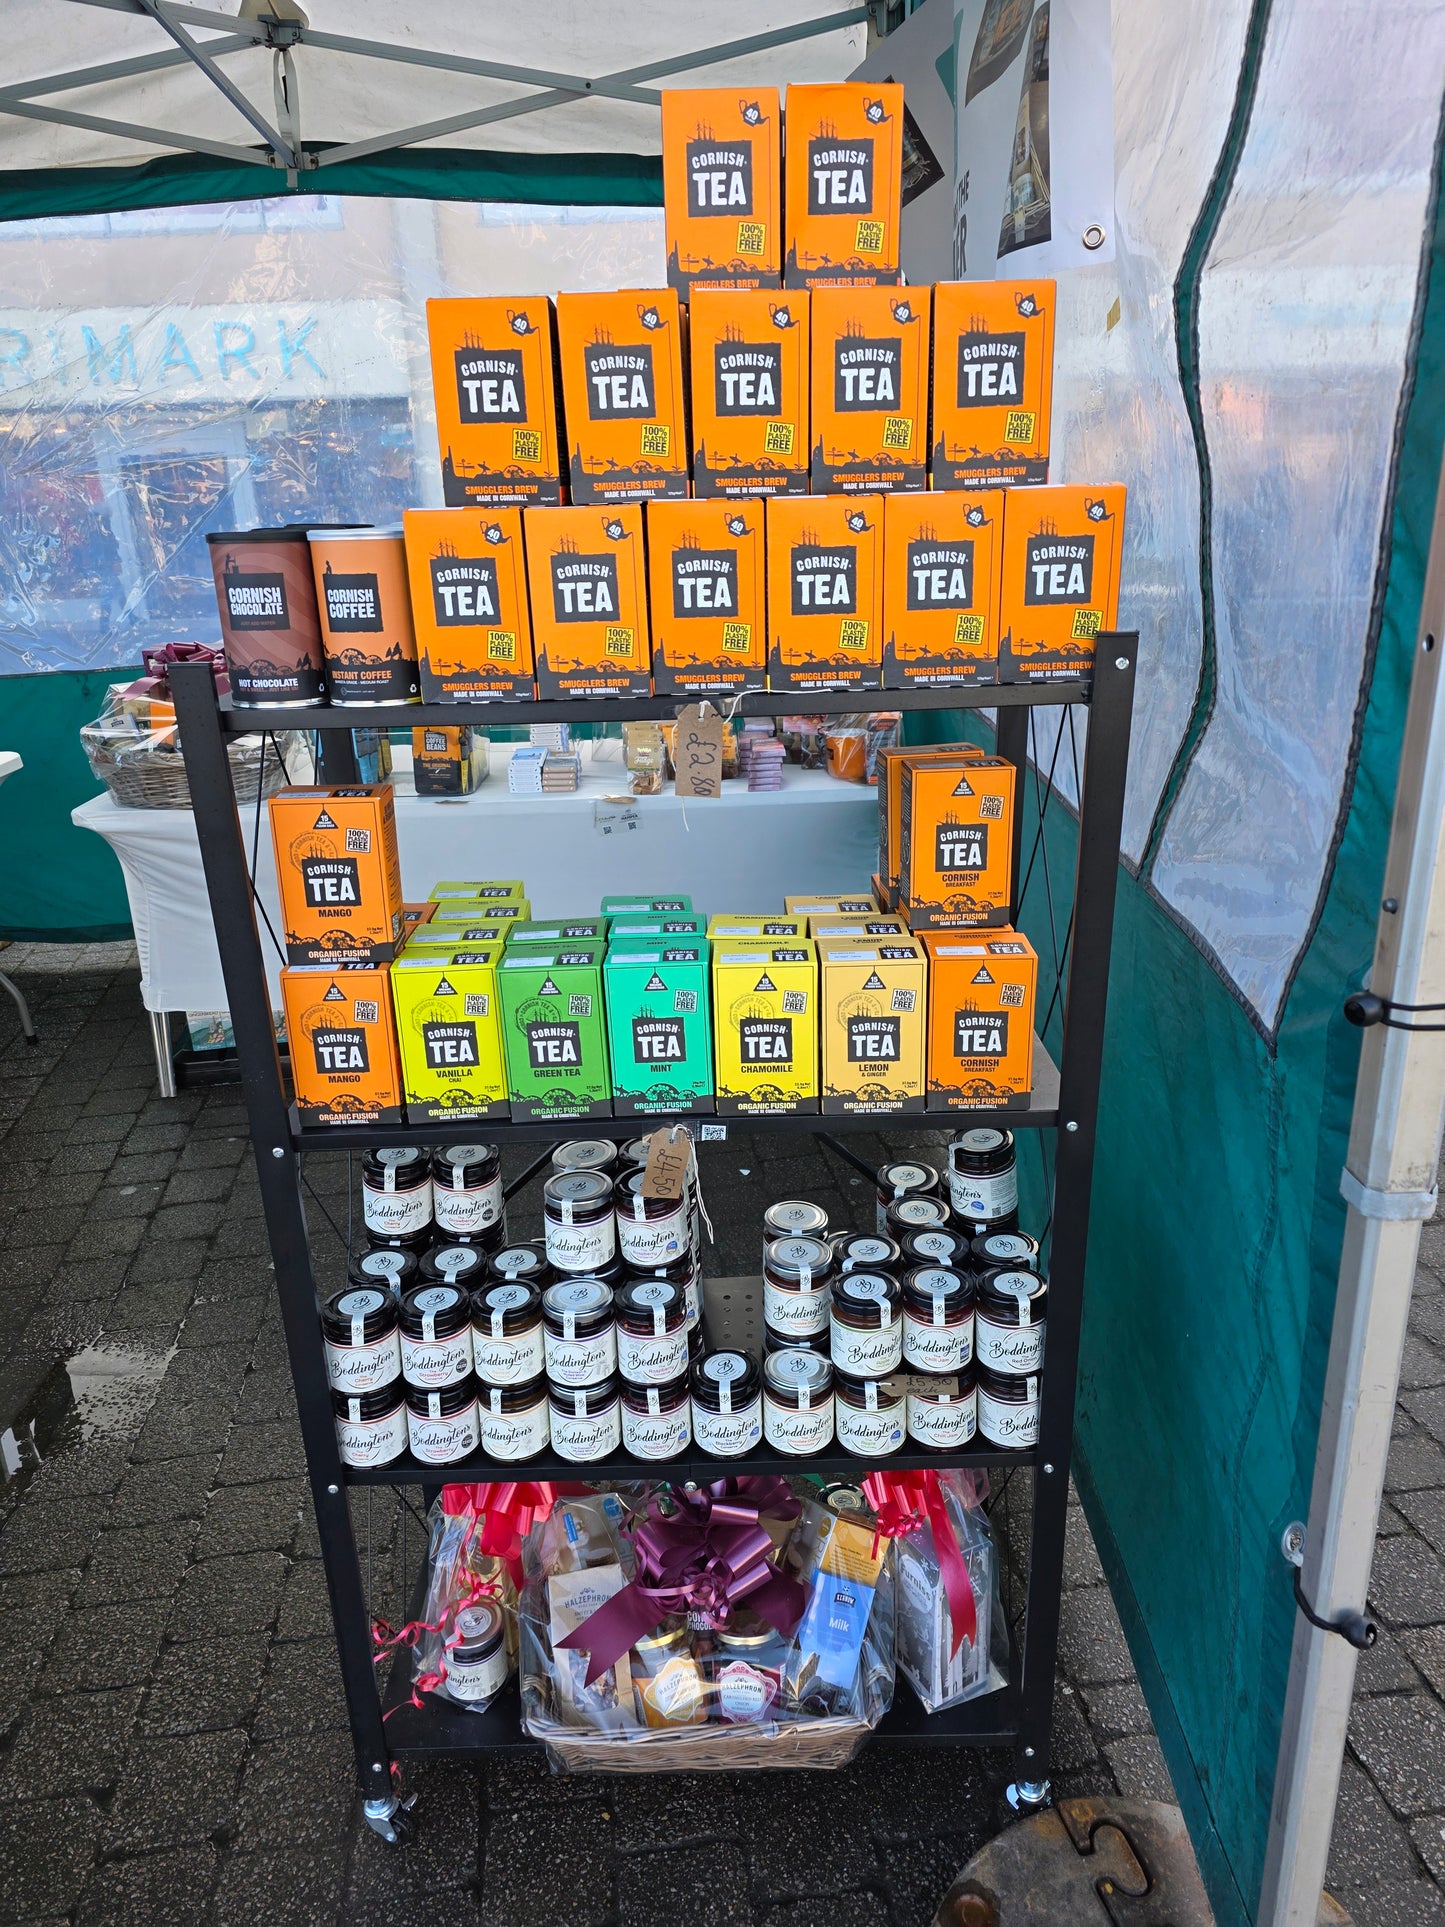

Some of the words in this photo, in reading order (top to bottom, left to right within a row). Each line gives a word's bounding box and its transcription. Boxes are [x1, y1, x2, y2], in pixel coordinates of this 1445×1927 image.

[692, 151, 744, 169] CORNISH
[813, 149, 866, 167] CORNISH
[693, 171, 747, 206] TEA
[814, 169, 866, 204] TEA
[688, 280, 735, 289] SMUGGLERS
[737, 279, 760, 288] BREW
[805, 278, 852, 287] SMUGGLERS
[853, 277, 877, 286] BREW
[840, 348, 894, 365] CORNISH
[964, 343, 1018, 361] CORNISH
[591, 355, 645, 373] CORNISH
[720, 353, 774, 370] CORNISH
[461, 360, 515, 376] CORNISH
[841, 367, 894, 401] TEA
[964, 362, 1017, 397] TEA
[592, 374, 649, 409] TEA
[721, 372, 775, 406] TEA
[463, 379, 520, 413] TEA
[768, 424, 792, 434] 100%
[515, 431, 539, 442] 100%
[767, 439, 791, 450] FREE
[515, 446, 539, 457] FREE
[832, 473, 880, 483] SMUGGLERS
[881, 472, 905, 481] BREW
[954, 468, 1002, 479] SMUGGLERS
[1003, 466, 1027, 476] BREW
[593, 481, 641, 491] SMUGGLERS
[642, 480, 666, 489] BREW
[715, 478, 763, 487] SMUGGLERS
[764, 477, 788, 486] BREW
[465, 485, 513, 495] SMUGGLERS
[515, 485, 538, 494] BREW
[488, 529, 500, 540] 40
[913, 550, 966, 567] CORNISH
[1032, 545, 1086, 561] CORNISH
[677, 559, 730, 575] CORNISH
[796, 555, 849, 571] CORNISH
[436, 567, 489, 583] CORNISH
[557, 563, 609, 579] CORNISH
[913, 568, 966, 600] TEA
[1032, 563, 1085, 595] TEA
[228, 587, 282, 603] CORNISH
[327, 588, 374, 602] CORNISH
[678, 577, 732, 608] TEA
[797, 573, 850, 605] TEA
[438, 585, 495, 616] TEA
[558, 581, 613, 613] TEA
[230, 603, 284, 616] CHOCOLATE
[329, 603, 376, 618] COFFEE
[958, 616, 983, 626] 100%
[956, 630, 981, 640] FREE
[904, 667, 951, 676] SMUGGLERS
[953, 666, 976, 674] BREW
[1019, 662, 1067, 671] SMUGGLERS
[1068, 661, 1093, 670] BREW
[331, 670, 358, 680] INSTANT
[360, 670, 392, 679] COFFEE
[674, 674, 721, 683] SMUGGLERS
[722, 674, 745, 682] BREW
[790, 672, 837, 681] SMUGGLERS
[838, 671, 862, 679] BREW
[238, 679, 251, 688] HOT
[252, 678, 299, 688] CHOCOLATE
[442, 682, 489, 691] SMUGGLERS
[490, 682, 513, 690] BREW
[558, 679, 605, 688] SMUGGLERS
[607, 678, 630, 687] BREW
[940, 830, 982, 842] CORNISH
[940, 843, 982, 866] TEA
[307, 864, 351, 876] CORNISH
[942, 873, 980, 882] CORNISH
[308, 877, 356, 901] TEA
[318, 909, 352, 918] MANGO
[930, 913, 961, 922] ORGANIC
[308, 950, 342, 959] ORGANIC
[342, 949, 371, 957] FUSION
[1003, 985, 1024, 994] 100%
[1002, 995, 1022, 1004] FREE
[636, 1023, 678, 1034] CORNISH
[852, 1022, 894, 1033] CORNISH
[959, 1017, 1002, 1028] CORNISH
[427, 1028, 470, 1040] CORNISH
[531, 1028, 573, 1039] CORNISH
[744, 1024, 786, 1035] CORNISH
[317, 1034, 360, 1045] CORNISH
[852, 1034, 895, 1057] TEA
[958, 1030, 1002, 1052] TEA
[428, 1039, 475, 1063] TEA
[532, 1039, 577, 1062] TEA
[637, 1035, 681, 1058] TEA
[744, 1036, 788, 1058] TEA
[318, 1046, 365, 1068] TEA
[960, 1059, 1000, 1067] CORNISH
[436, 1069, 473, 1078] VANILLA
[534, 1069, 563, 1078] GREEN
[565, 1068, 581, 1077] TEA
[650, 1064, 672, 1073] MINT
[740, 1064, 793, 1074] CHAMOMILE
[859, 1064, 889, 1072] LEMON
[328, 1075, 361, 1084] MANGO
[948, 1097, 980, 1105] ORGANIC
[428, 1107, 461, 1117] ORGANIC
[461, 1106, 488, 1114] FUSION
[828, 1617, 850, 1632] Milk
